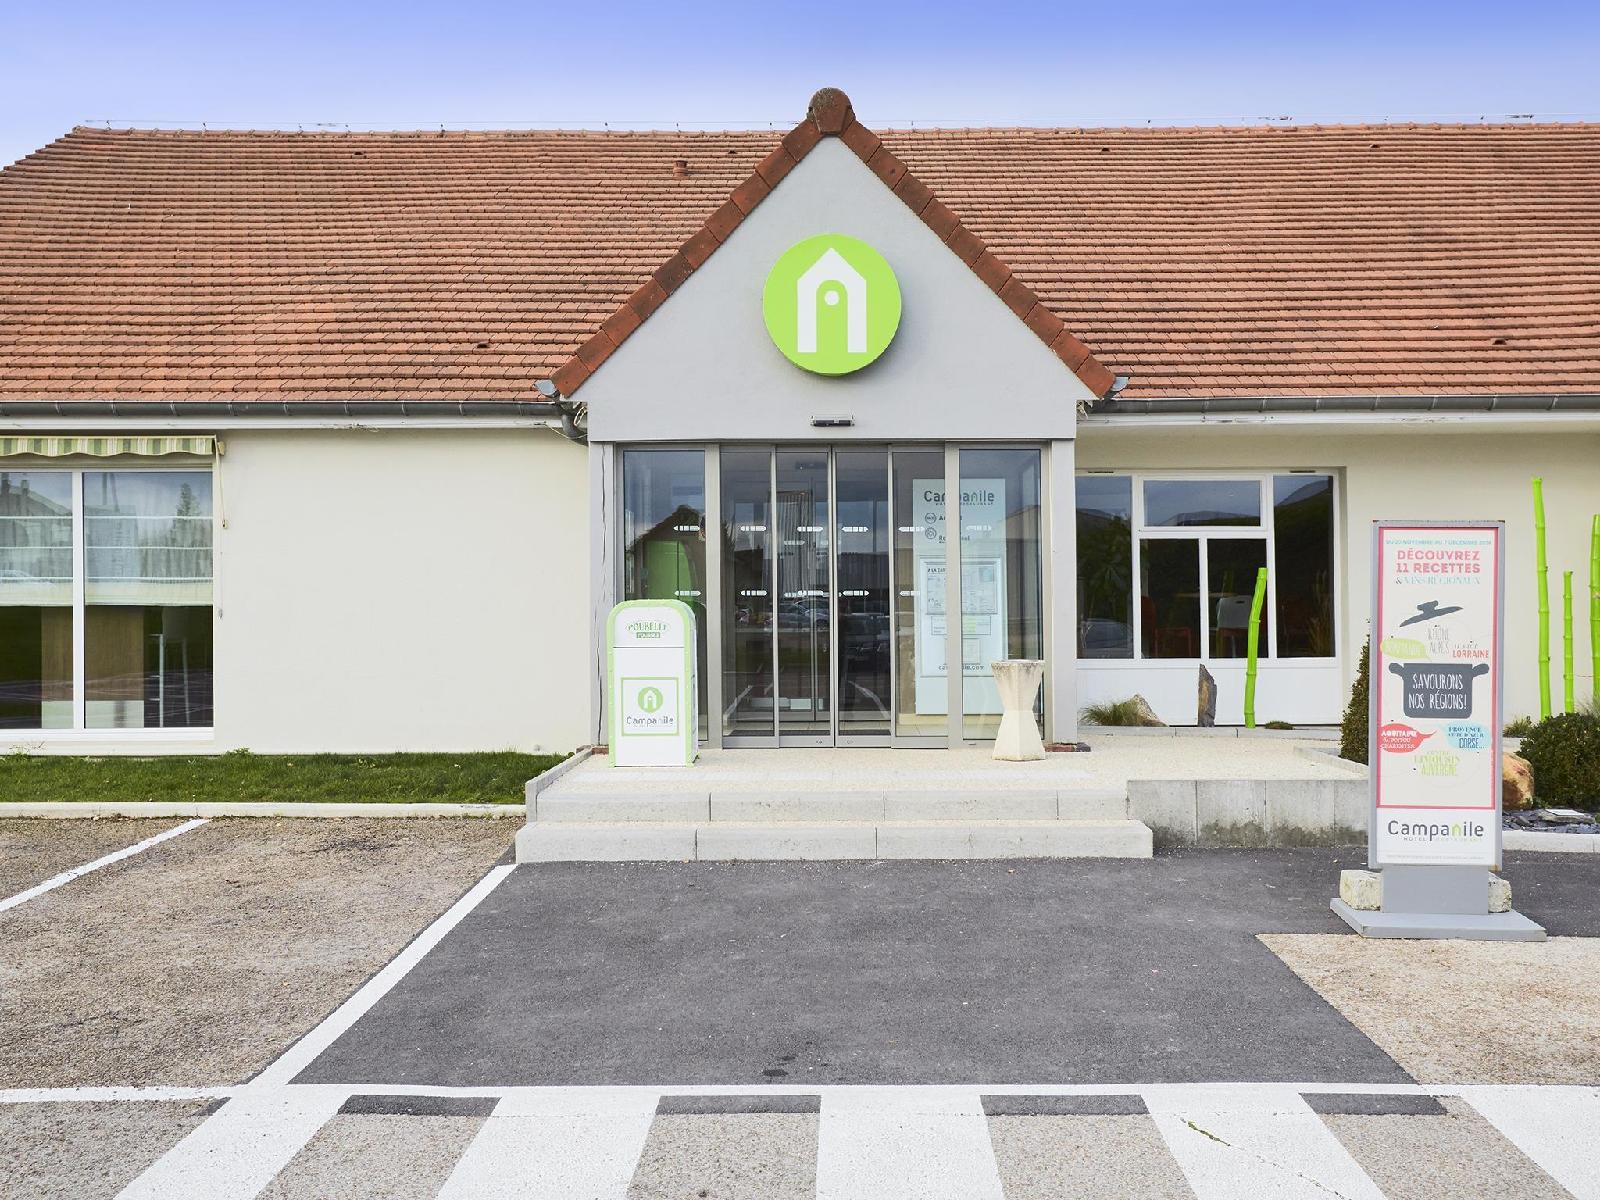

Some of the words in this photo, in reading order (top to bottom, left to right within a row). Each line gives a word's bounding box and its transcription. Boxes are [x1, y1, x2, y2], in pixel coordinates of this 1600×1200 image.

[924, 490, 995, 503] Caanile
[1397, 547, 1480, 561] DÉCOUVREZ
[1396, 563, 1408, 573] 11
[1413, 563, 1481, 573] RECETTES
[1395, 577, 1402, 585] &
[1453, 650, 1488, 658] LORRAINE
[1412, 673, 1464, 690] SAVOURONS
[1408, 693, 1425, 709] NOS
[1430, 690, 1467, 710] RÉGIONS!
[626, 716, 674, 727] Campanile
[1387, 820, 1484, 841] Campanile
